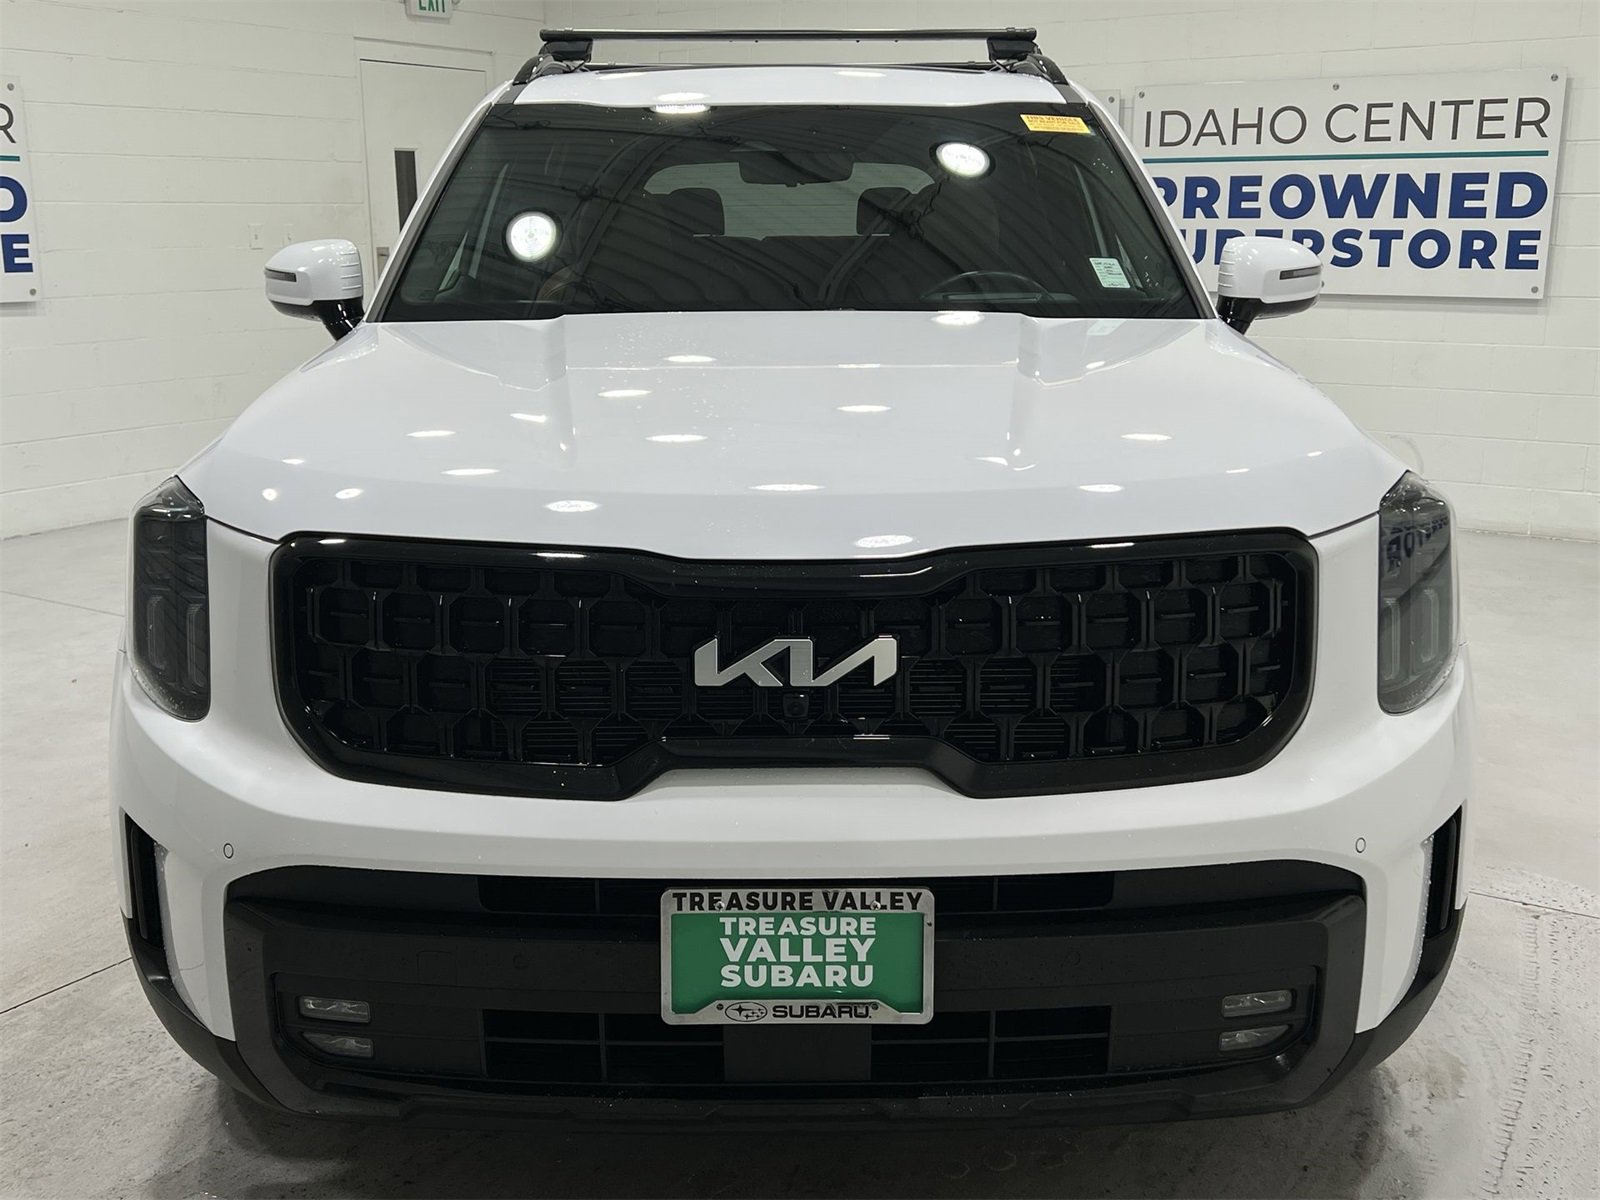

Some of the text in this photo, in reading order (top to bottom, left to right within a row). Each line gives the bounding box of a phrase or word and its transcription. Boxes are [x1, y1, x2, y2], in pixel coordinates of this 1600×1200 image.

[1144, 97, 1551, 148] IDAHO CENTER
[1179, 229, 1542, 270] USTORE
[694, 636, 897, 687] KIA
[672, 891, 923, 912] TREASURE VALLEY
[719, 917, 876, 936] TREASURE
[719, 937, 876, 962] VALLEY
[720, 964, 874, 987] SUBARU
[772, 1004, 870, 1019] SUBARU
